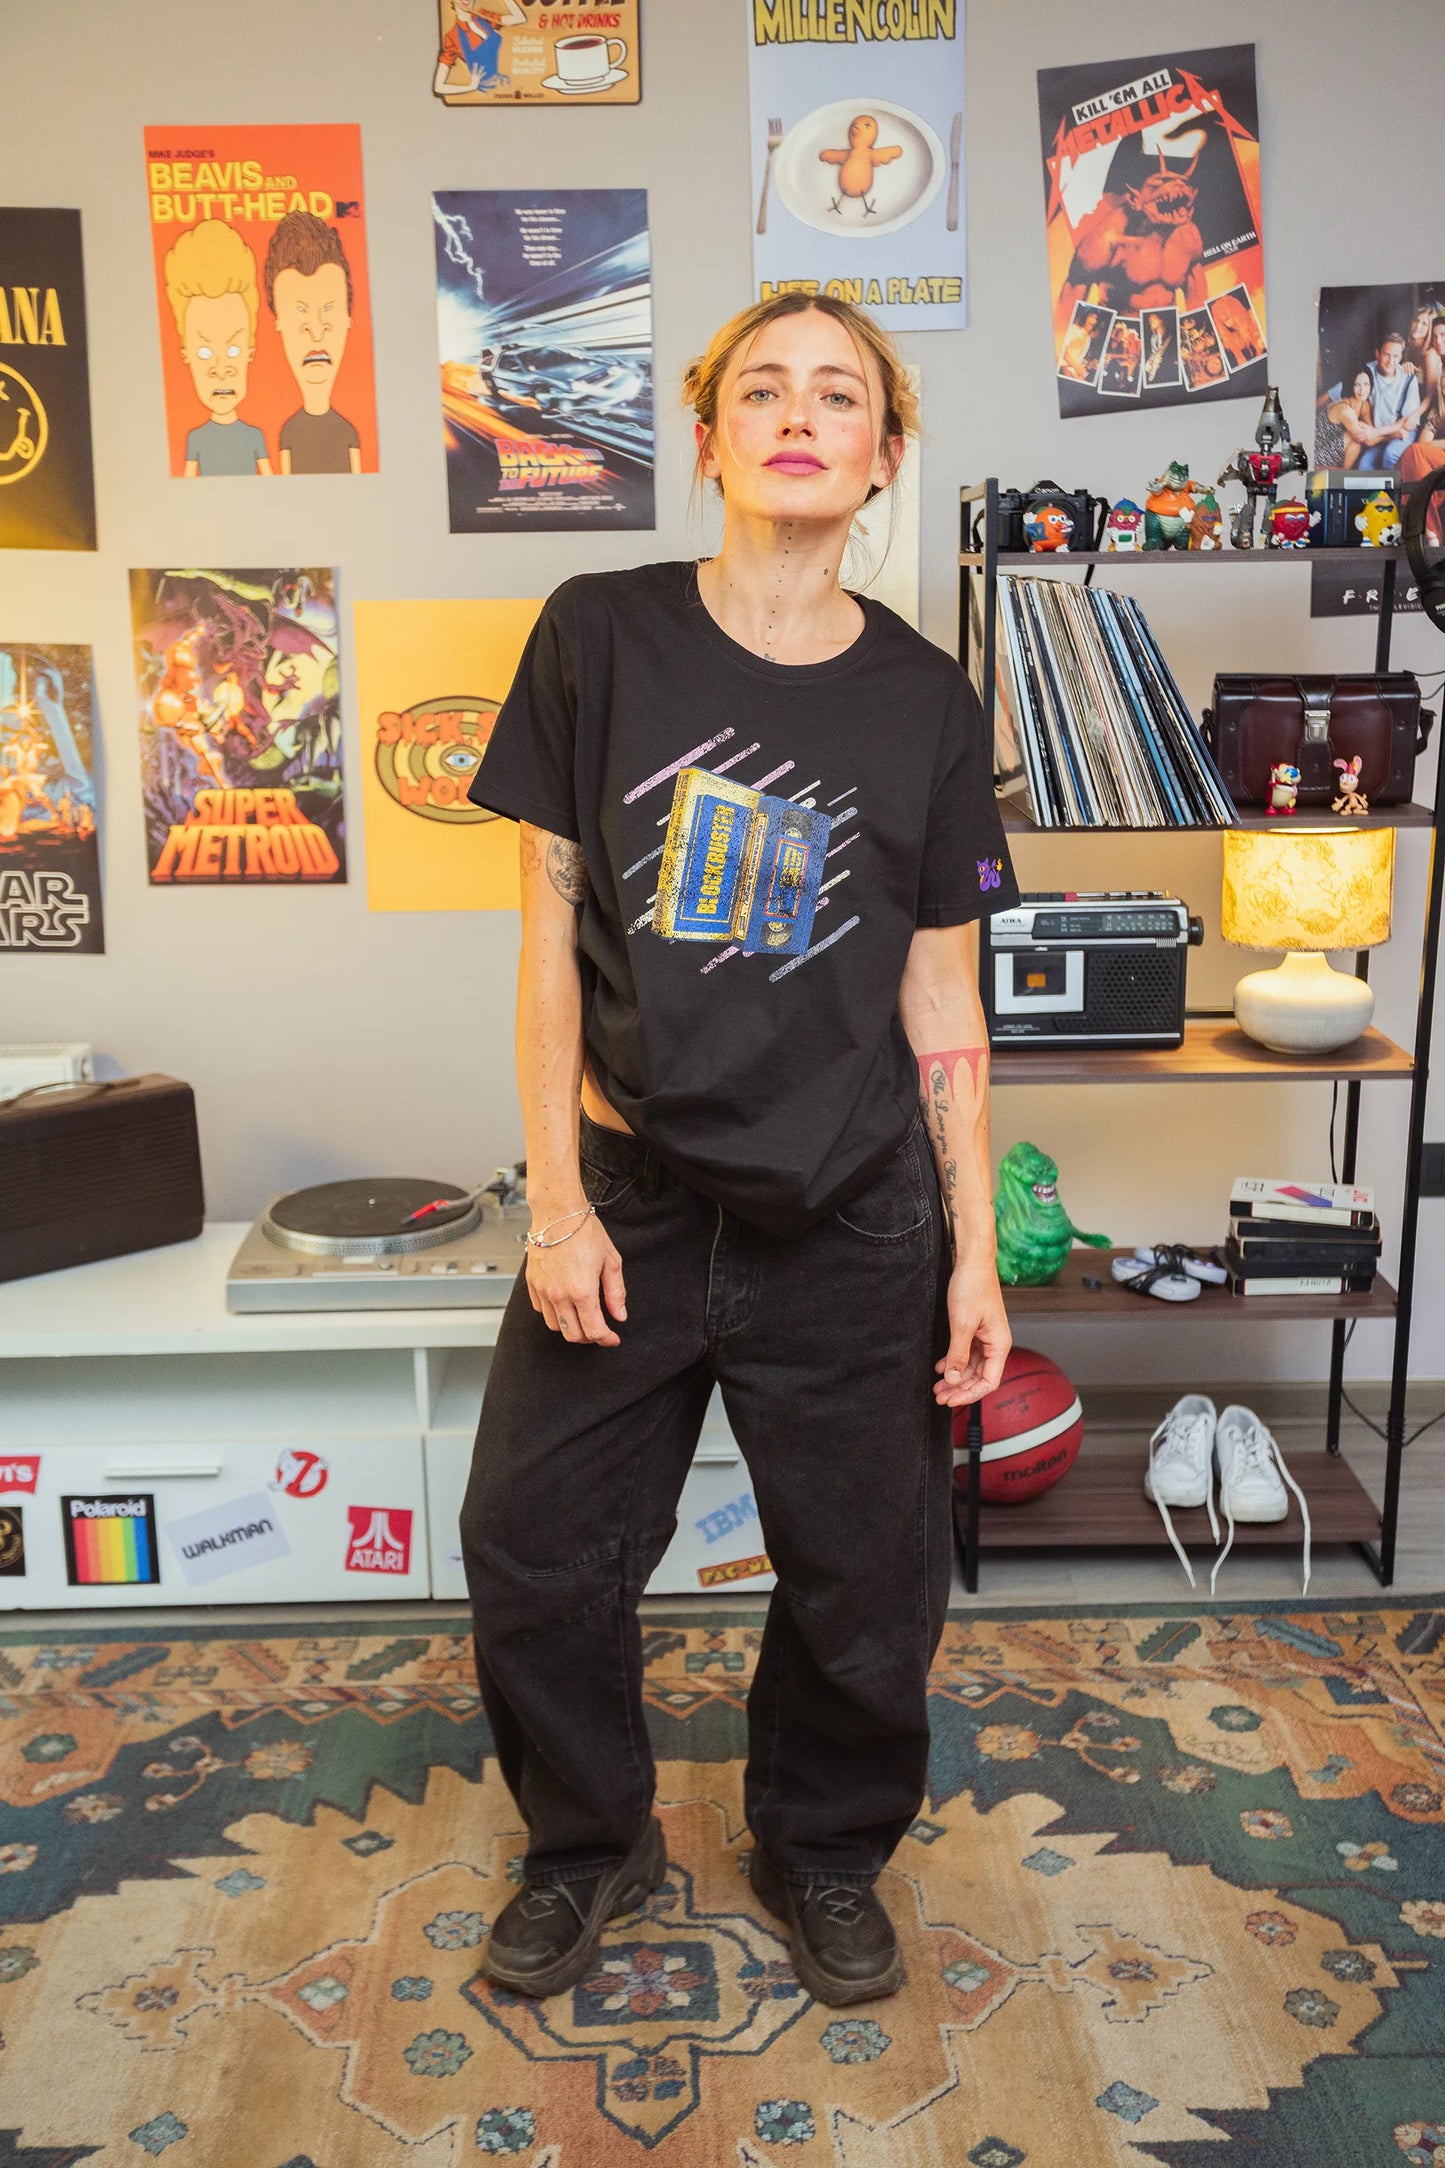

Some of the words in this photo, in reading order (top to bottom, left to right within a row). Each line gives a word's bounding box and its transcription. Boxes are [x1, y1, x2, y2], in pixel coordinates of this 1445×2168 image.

[551, 13, 575, 28] HOT
[576, 13, 621, 28] DRINKS
[754, 0, 956, 45] MILLENCOLIN
[1075, 99, 1109, 122] KILL
[1142, 71, 1171, 97] ALL
[1048, 67, 1256, 180] METALLICA
[149, 161, 264, 191] BEAVIS
[263, 175, 298, 190] AND
[151, 191, 334, 224] BUTT-HEAD
[1203, 245, 1222, 258] HELL
[1231, 231, 1256, 246] EARTH
[824, 278, 863, 304] ON
[866, 278, 883, 305] A
[887, 276, 963, 305] PLATE
[376, 710, 465, 748] SICK
[184, 787, 312, 828] SUPER
[151, 823, 341, 883] METROID
[696, 804, 735, 914] BLOCKBUSTER
[70, 1498, 147, 1519] Polaroid
[694, 1493, 758, 1546] IBM
[180, 1516, 274, 1561] WALKMAN
[349, 1549, 403, 1571] ATARI
